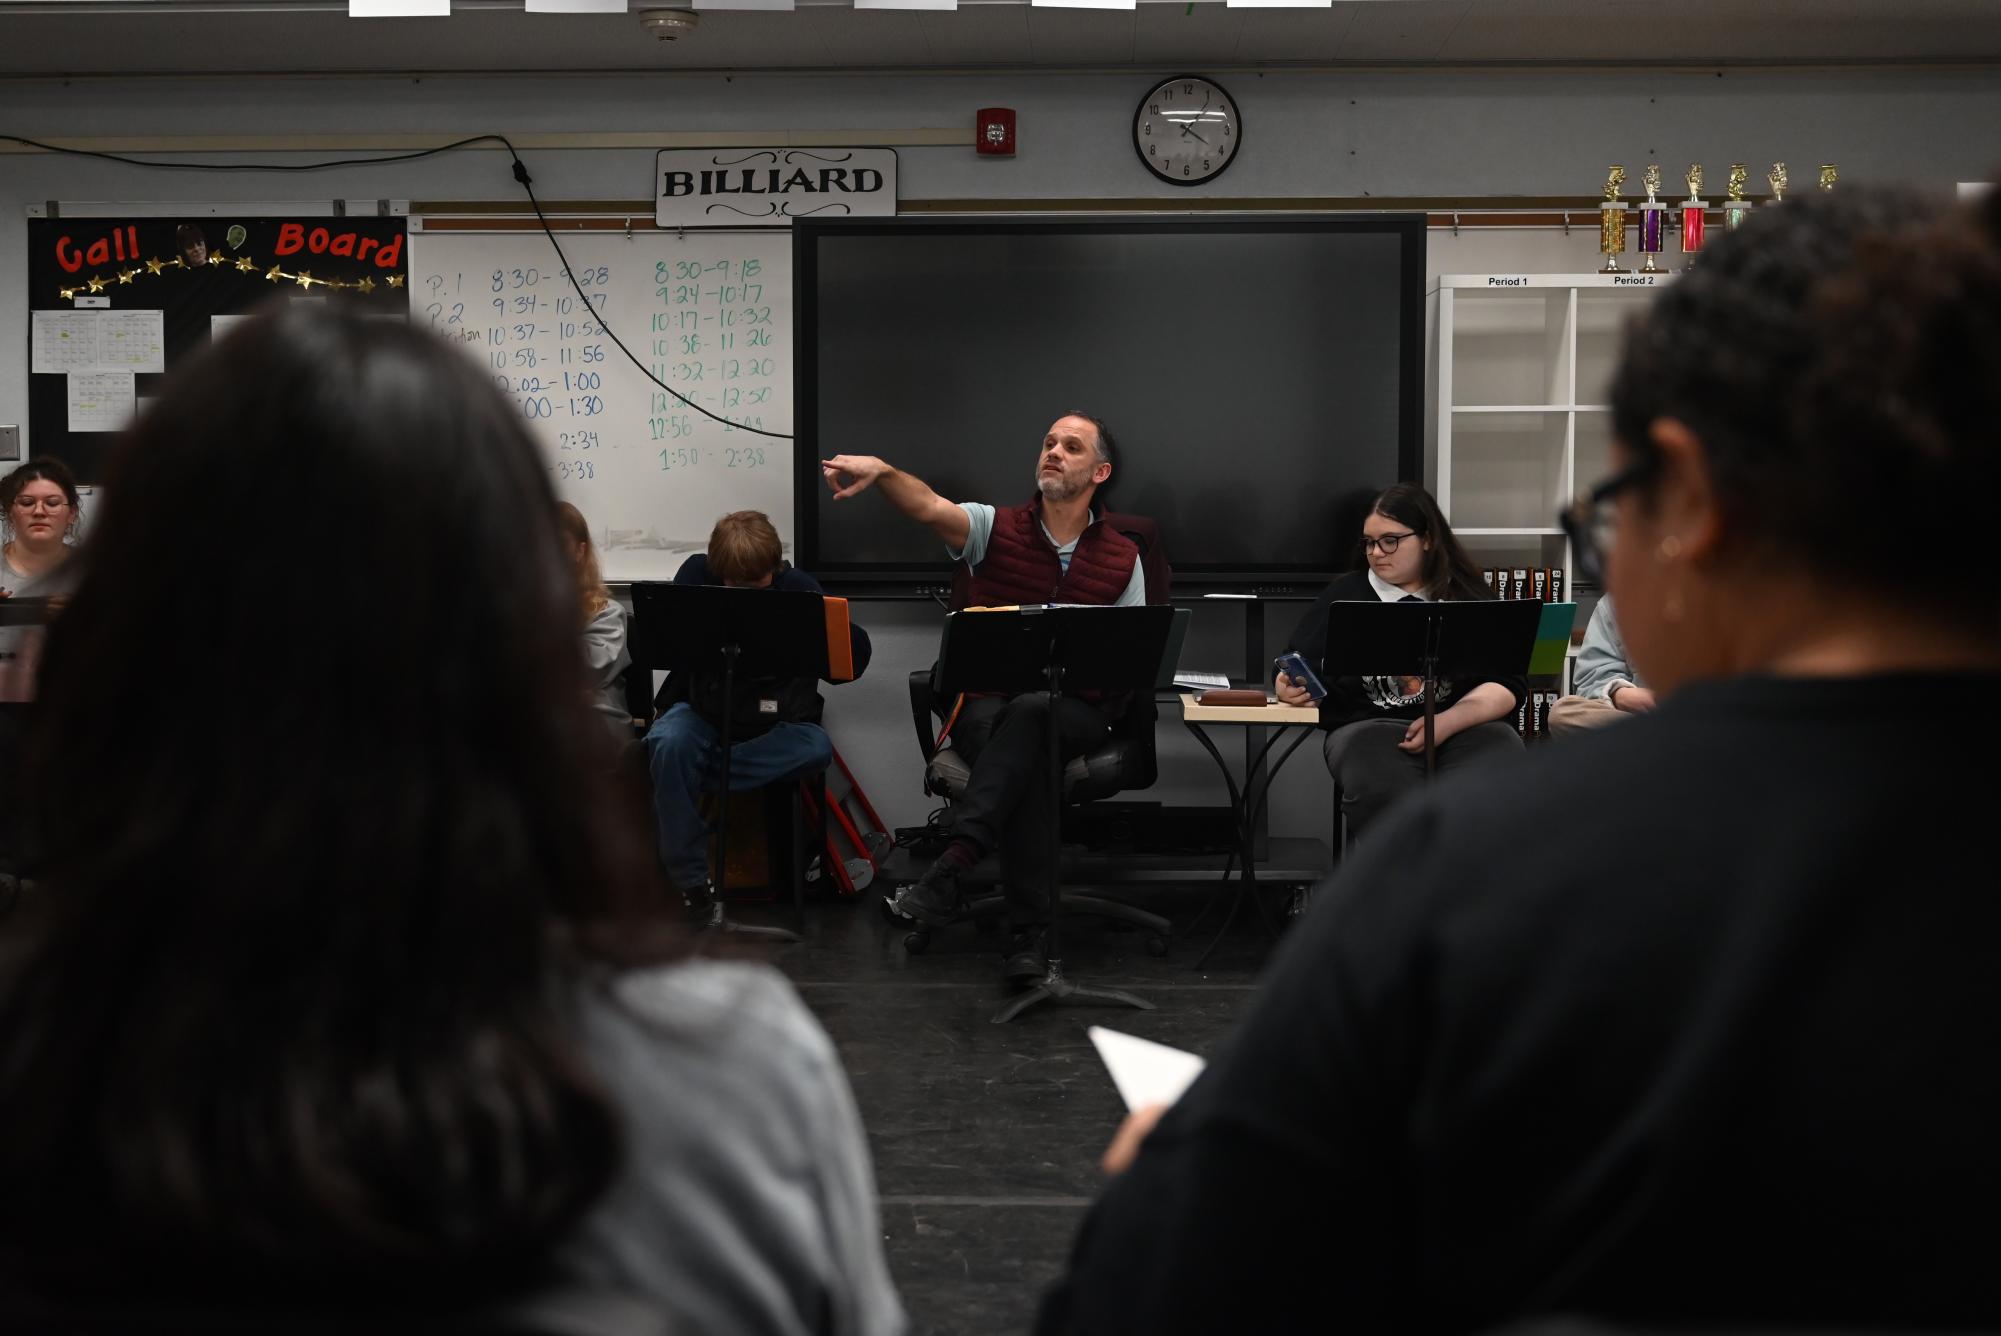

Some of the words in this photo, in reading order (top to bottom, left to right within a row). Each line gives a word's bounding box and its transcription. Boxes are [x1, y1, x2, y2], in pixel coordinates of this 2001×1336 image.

[1163, 90, 1173, 100] 11
[1184, 84, 1193, 95] 12
[1206, 90, 1211, 100] 1
[1149, 104, 1159, 115] 10
[1145, 124, 1151, 136] 9
[1224, 124, 1230, 136] 3
[1150, 144, 1156, 155] 8
[1218, 145, 1224, 156] 4
[1164, 160, 1170, 171] 7
[1183, 165, 1190, 176] 6
[1203, 160, 1210, 170] 5
[662, 168, 883, 197] BILLIARD
[55, 224, 141, 273] Call
[274, 222, 403, 269] Board
[1488, 278, 1520, 286] Period
[1523, 278, 1527, 286] 1
[1614, 276, 1646, 285] Period
[1648, 277, 1654, 285] 2
